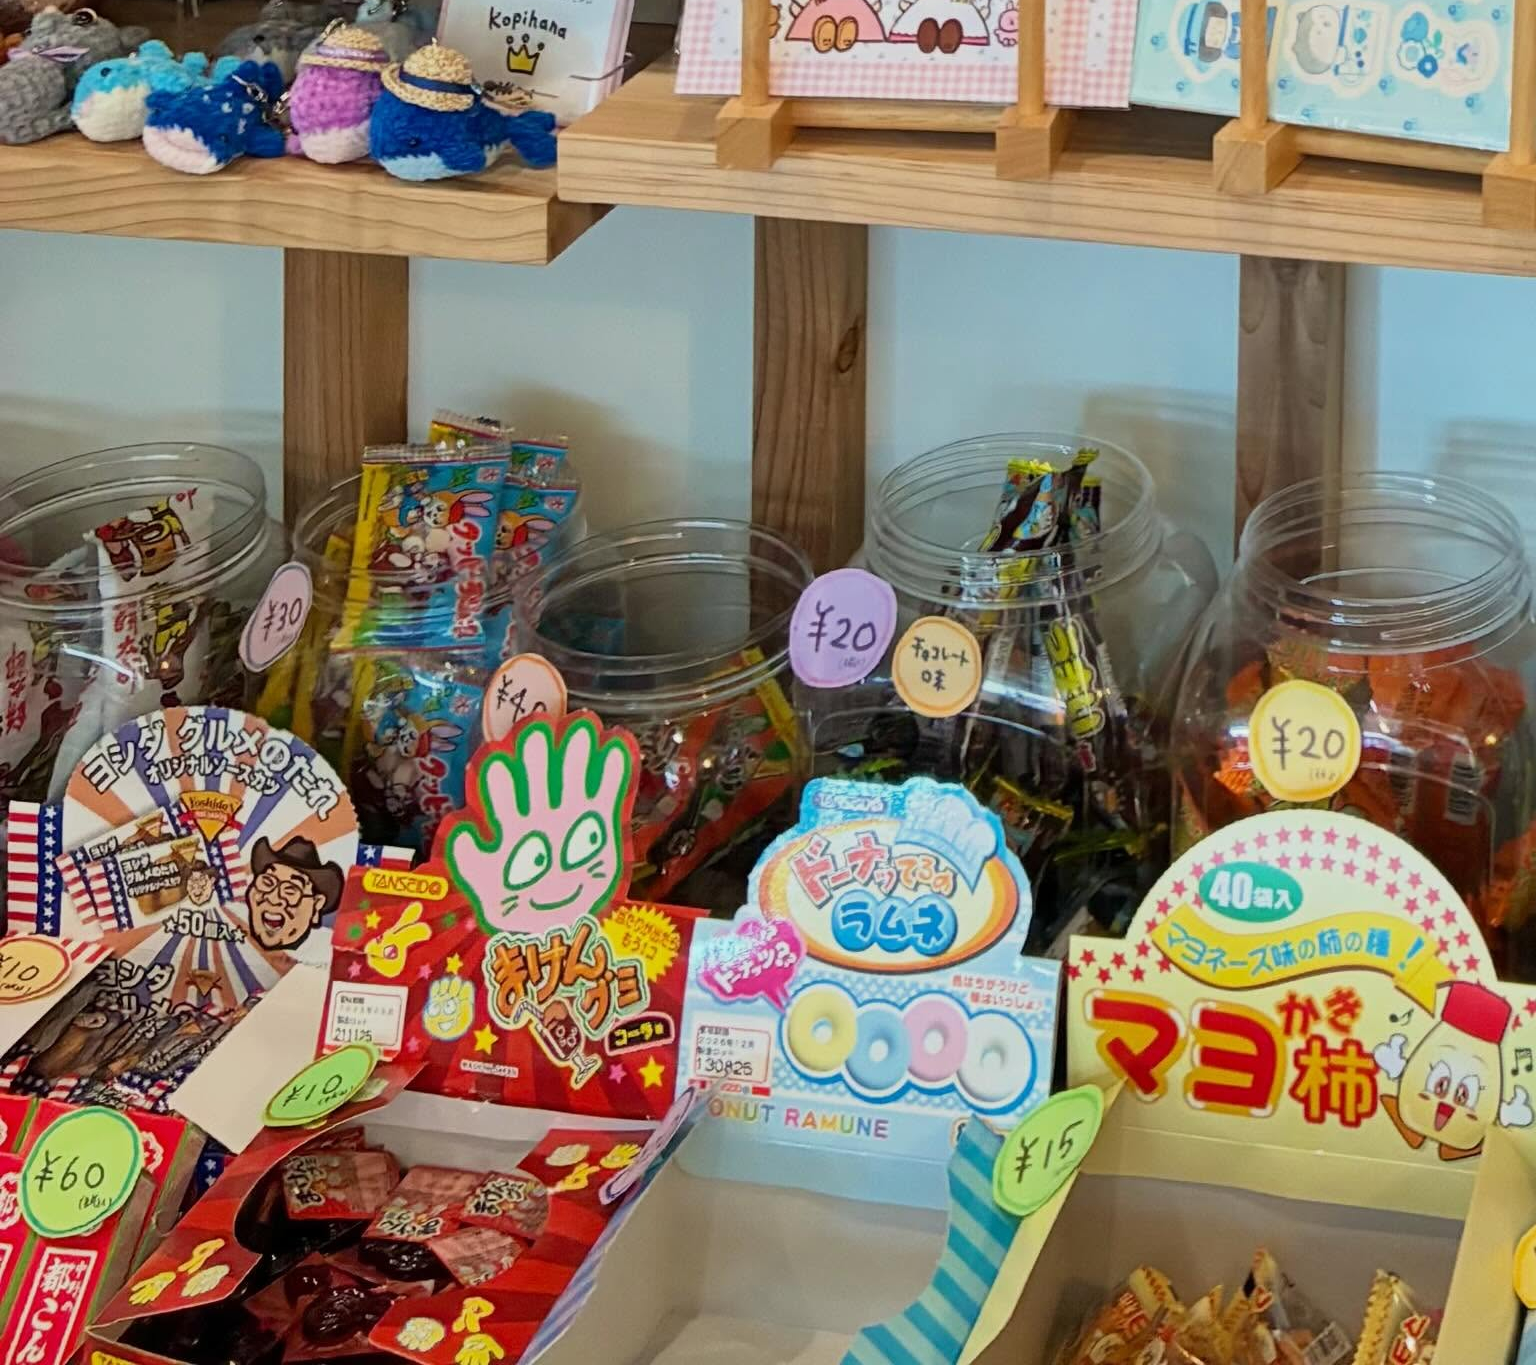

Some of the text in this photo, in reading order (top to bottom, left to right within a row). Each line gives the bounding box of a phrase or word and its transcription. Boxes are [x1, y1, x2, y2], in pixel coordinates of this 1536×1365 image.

[264, 597, 304, 642] ¥30
[807, 599, 878, 653] ¥20
[1271, 715, 1346, 771] ¥20
[82, 719, 165, 795] ヨシダ
[176, 715, 341, 822] グルメのたれ
[1208, 872, 1294, 911] 40袋入
[838, 899, 950, 947] ラムネ
[1276, 985, 1364, 1038] かき
[283, 1074, 343, 1106] ¥10
[784, 1107, 890, 1139] RAMUNE
[33, 1149, 106, 1194] ¥60
[1015, 1120, 1084, 1184] ¥15
